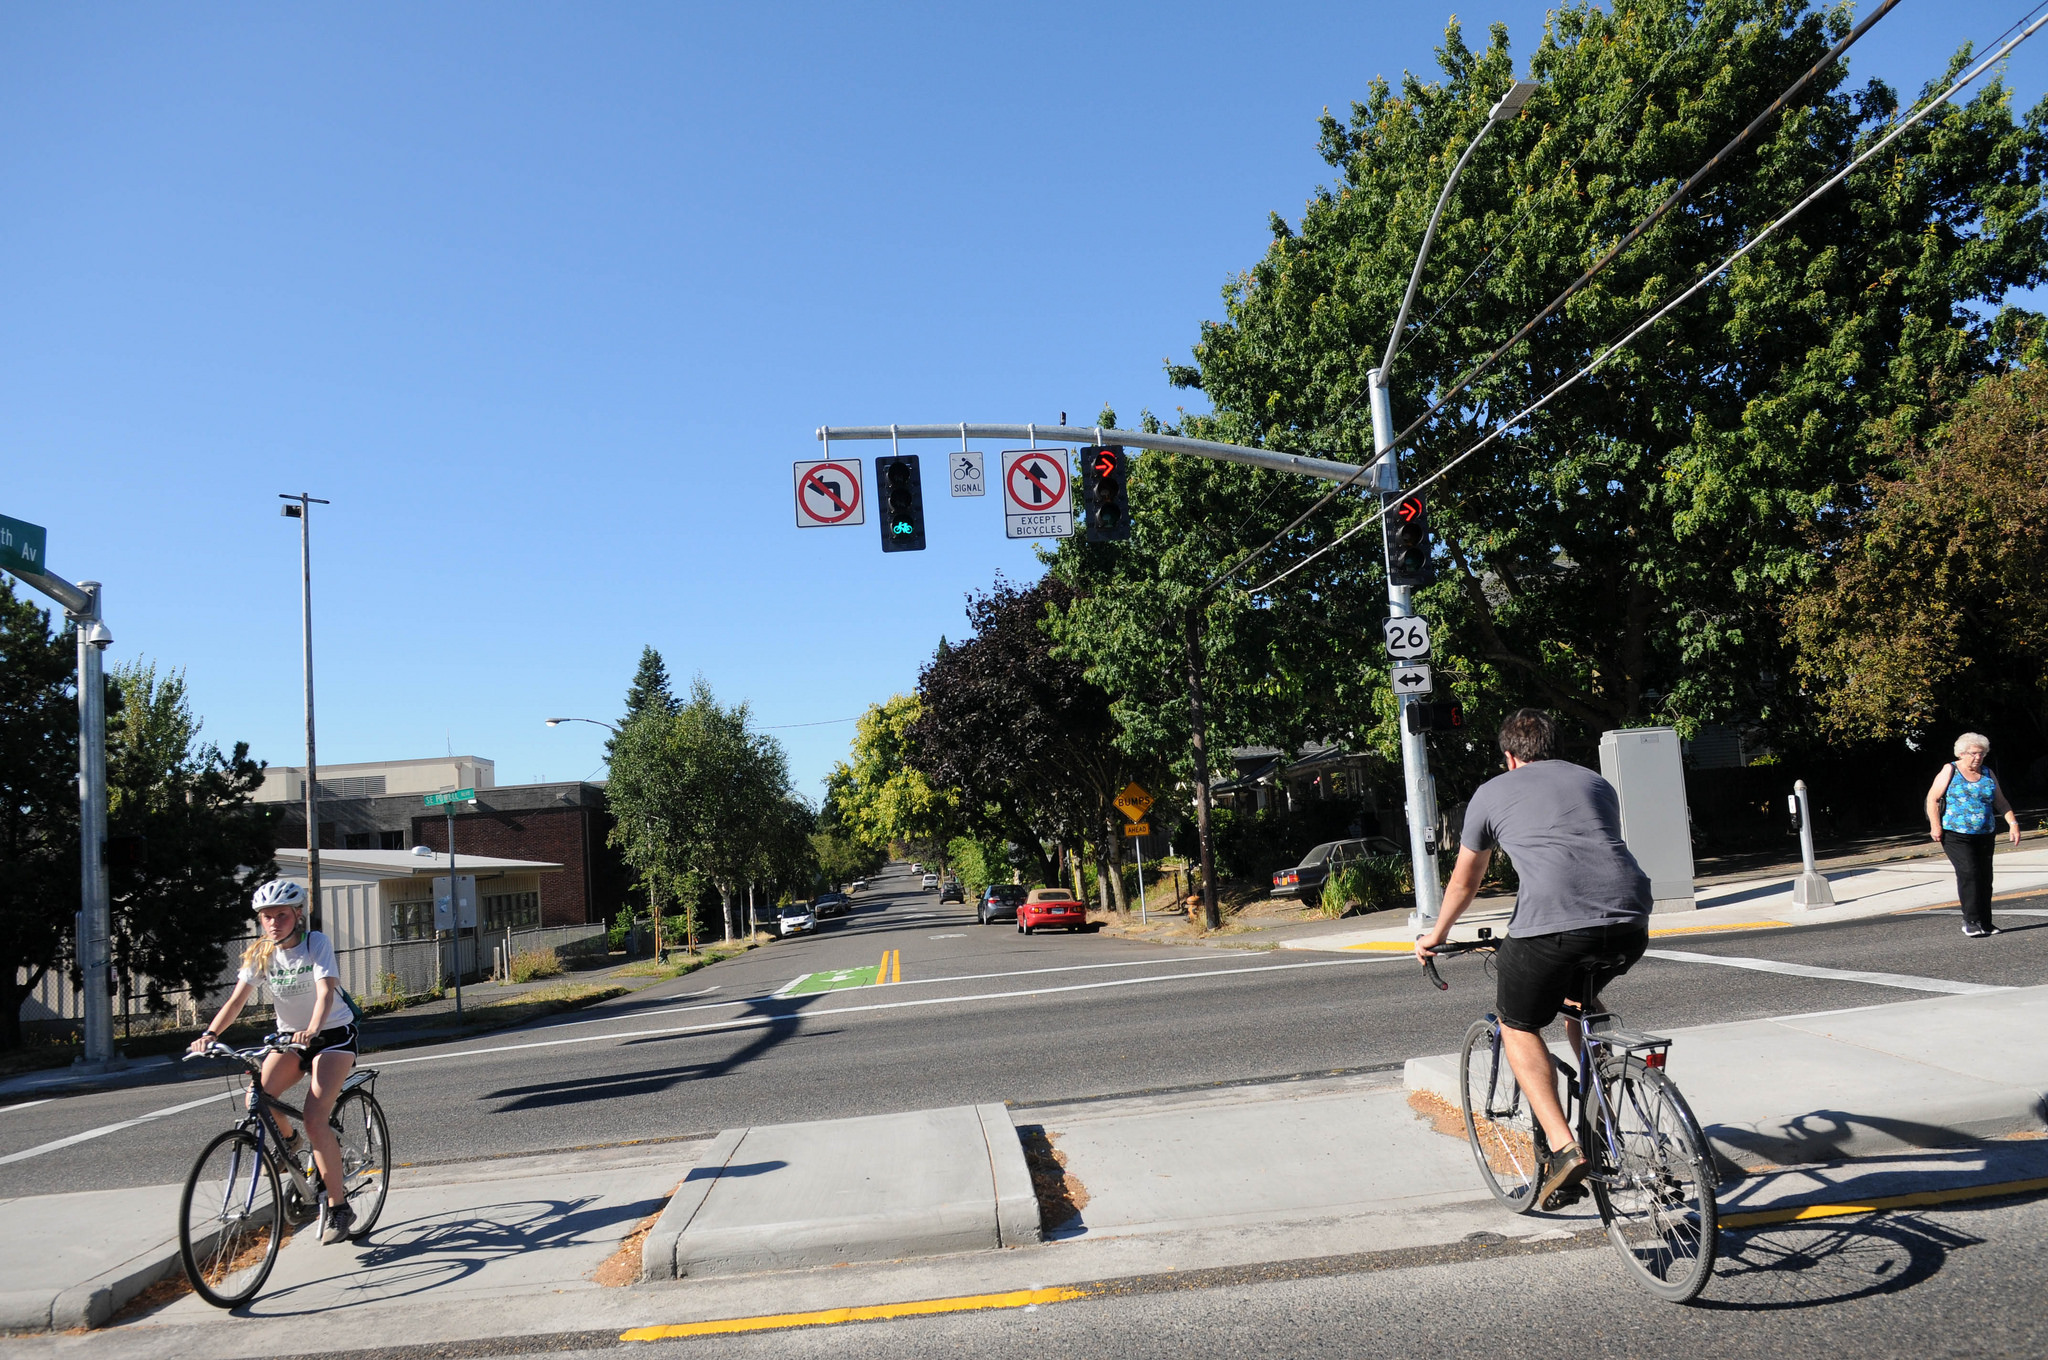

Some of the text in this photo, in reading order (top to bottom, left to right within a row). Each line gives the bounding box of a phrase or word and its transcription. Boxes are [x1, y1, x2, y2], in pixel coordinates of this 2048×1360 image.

[954, 484, 982, 492] SIGNAL
[1021, 515, 1056, 525] EXCEPT
[1016, 525, 1063, 535] BICYCLES
[21, 542, 37, 562] Av
[1389, 625, 1424, 650] 26
[425, 796, 434, 805] SE
[1118, 796, 1150, 807] BUMPS
[271, 977, 297, 985] PREP
